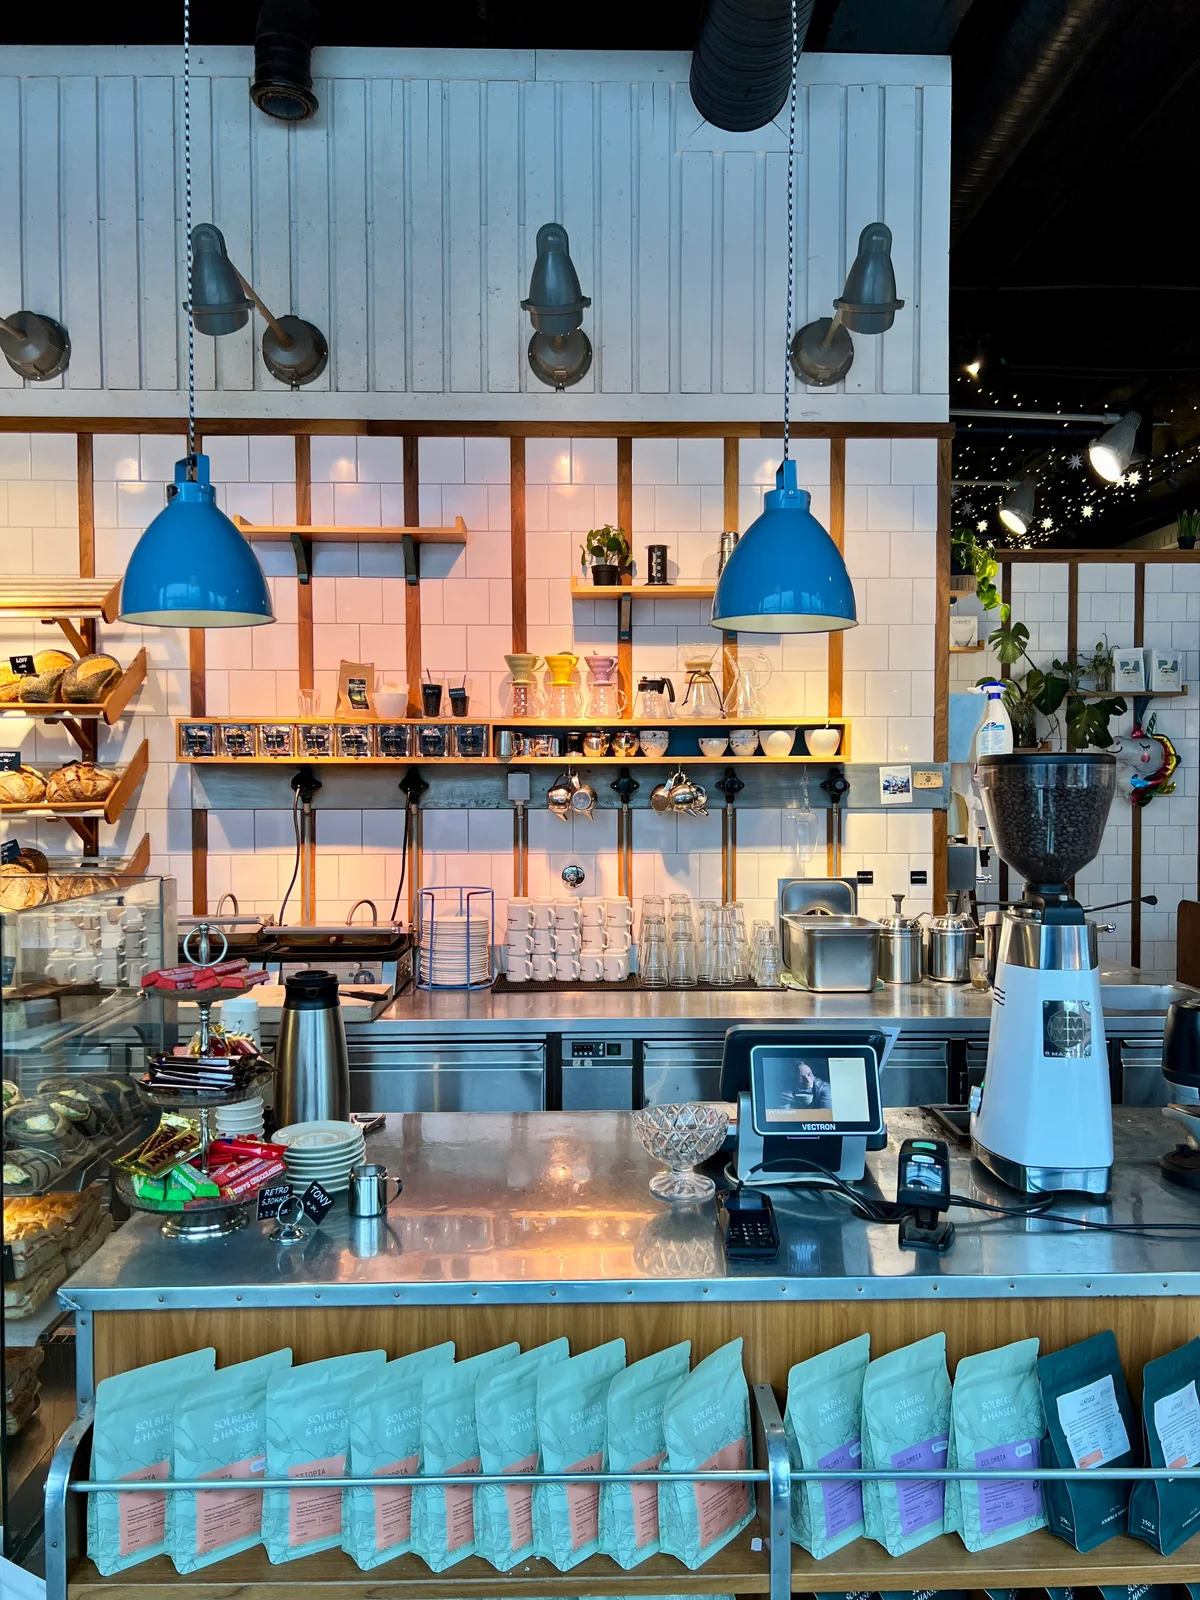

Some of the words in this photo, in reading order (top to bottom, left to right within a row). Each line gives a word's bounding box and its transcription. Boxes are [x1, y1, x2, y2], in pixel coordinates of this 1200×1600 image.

[146, 1134, 197, 1166] KROKAN
[264, 1186, 289, 1196] RETRO
[310, 1186, 332, 1206] TONY
[570, 1402, 602, 1422] SOLBERG
[692, 1400, 721, 1424] SOLBERG
[818, 1394, 847, 1415] SOLBERG
[894, 1393, 924, 1412] SOLBERG
[982, 1396, 1013, 1411] SOLBERG
[136, 1413, 174, 1432] SOLBER
[214, 1410, 255, 1430] SOLBERG
[576, 1413, 606, 1432] HANSEN
[694, 1426, 698, 1436] &
[700, 1411, 726, 1432] HANSEN
[826, 1404, 851, 1424] HANSEN
[896, 1415, 900, 1424] &
[902, 1404, 929, 1421] HANSEN
[988, 1407, 1016, 1421] HANSEN
[212, 1434, 219, 1442] &
[221, 1420, 258, 1440] HANSEN
[305, 1428, 311, 1436] &
[385, 1428, 392, 1438] &
[394, 1418, 421, 1434] HANSE
[454, 1429, 459, 1438] &
[510, 1427, 516, 1436] &
[635, 1425, 640, 1434] &
[134, 1436, 140, 1444] &
[897, 1453, 922, 1469] COLOMBIA
[981, 1454, 1006, 1467] COLOMBIA
